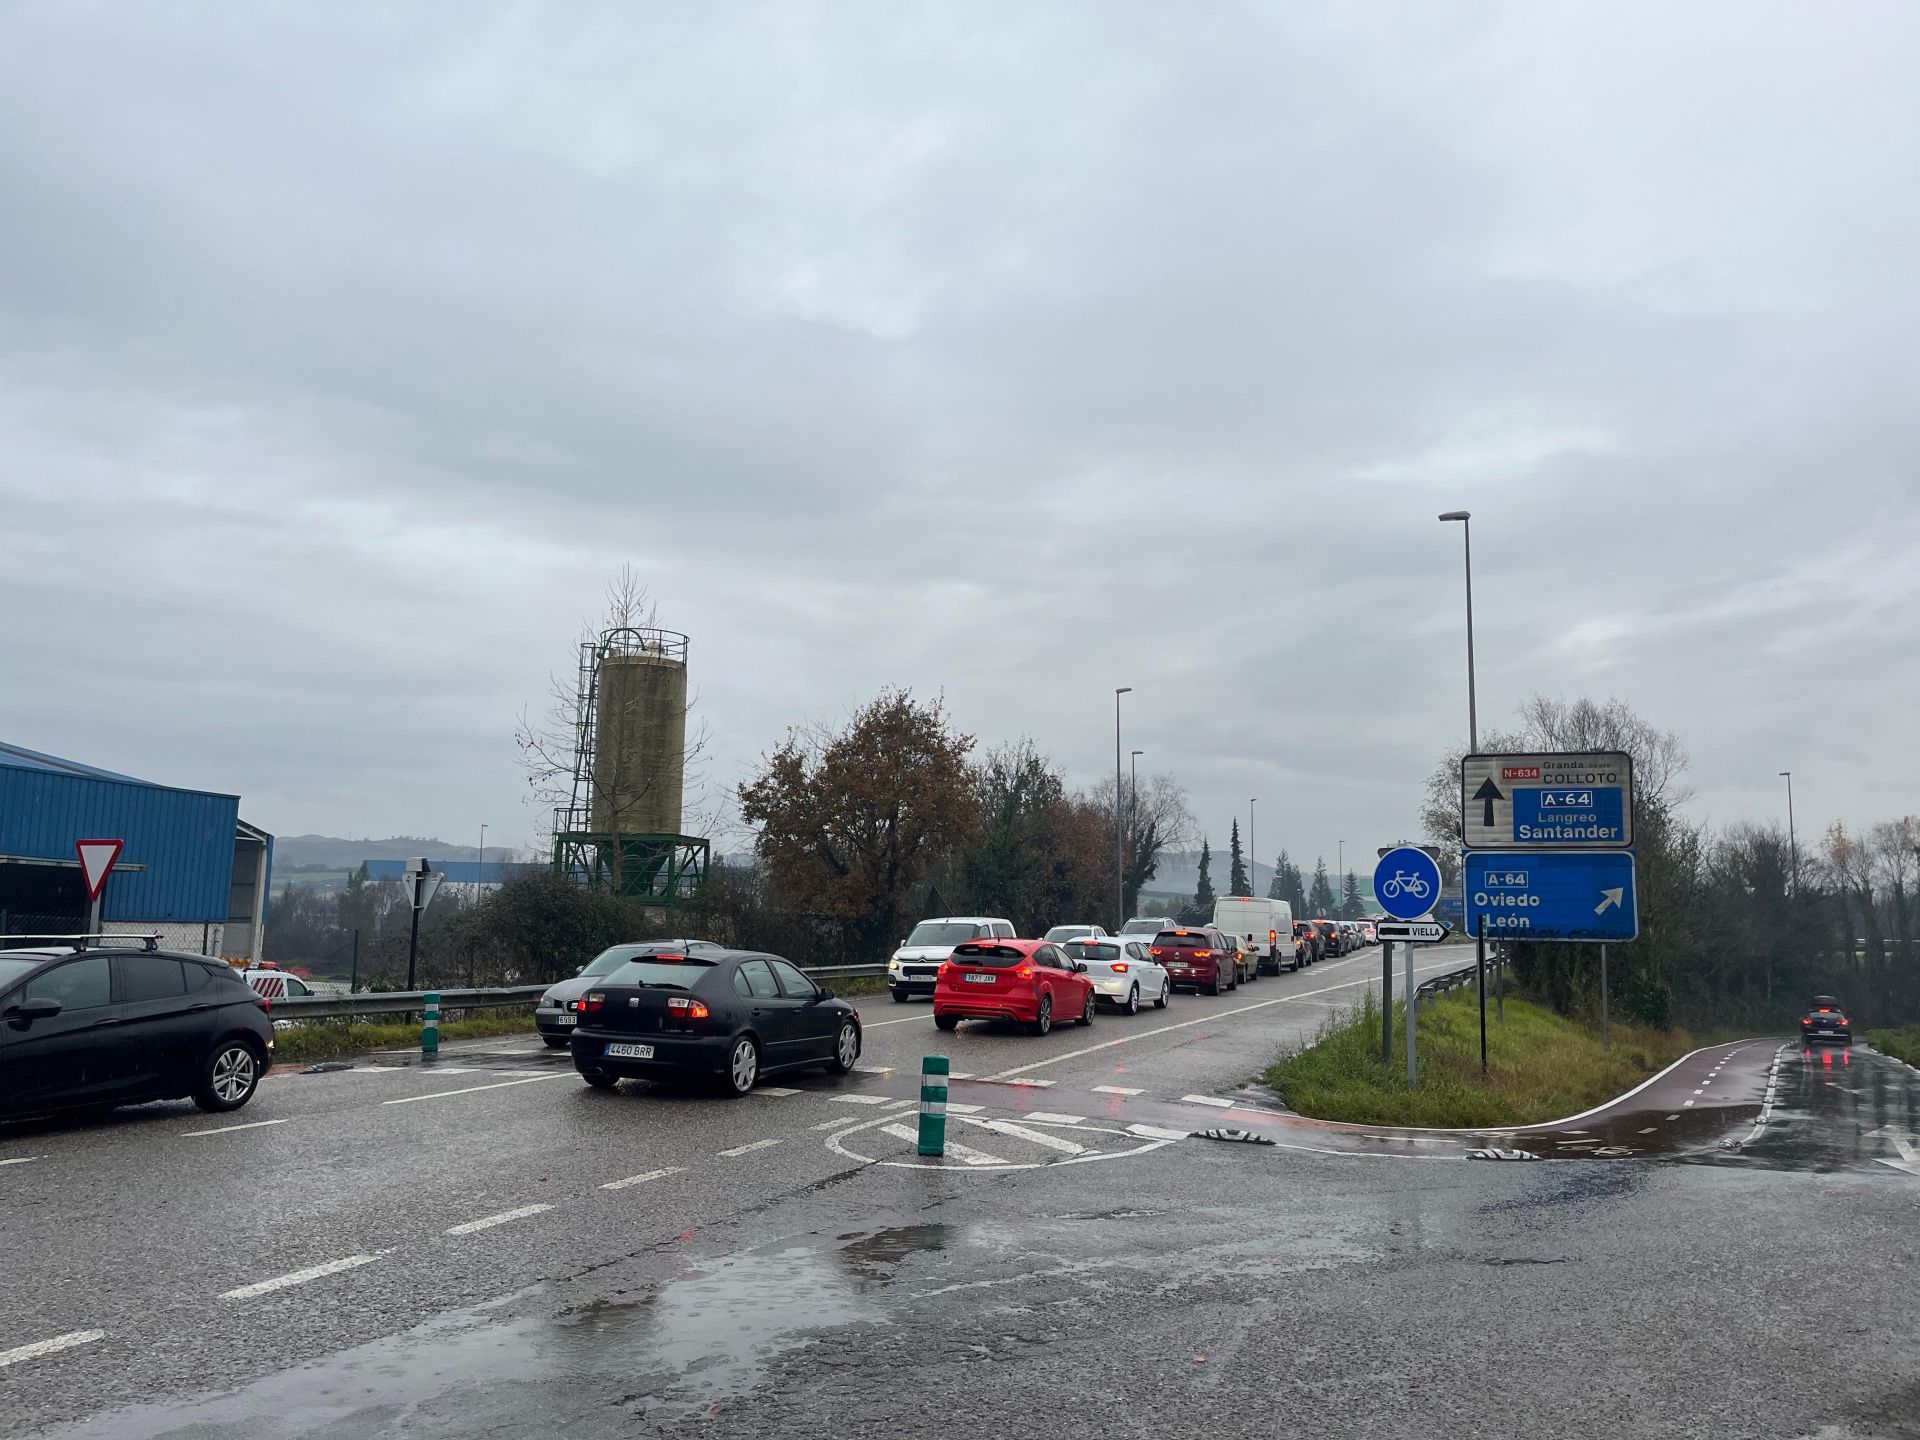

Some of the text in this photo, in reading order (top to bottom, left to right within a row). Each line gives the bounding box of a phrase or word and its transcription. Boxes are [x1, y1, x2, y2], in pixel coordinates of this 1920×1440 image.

[1543, 761, 1584, 769] Granda
[1504, 769, 1538, 778] N-634
[1543, 773, 1617, 784] COLLOTO
[1544, 793, 1590, 806] A-64
[1538, 812, 1597, 825] Langreo
[1519, 824, 1618, 839] Santander
[1488, 873, 1526, 886] A-64
[1474, 892, 1541, 907] Oviedo
[1486, 913, 1530, 928] León
[1412, 927, 1440, 936] VIELLA
[610, 1044, 652, 1057] 4460 BRR
